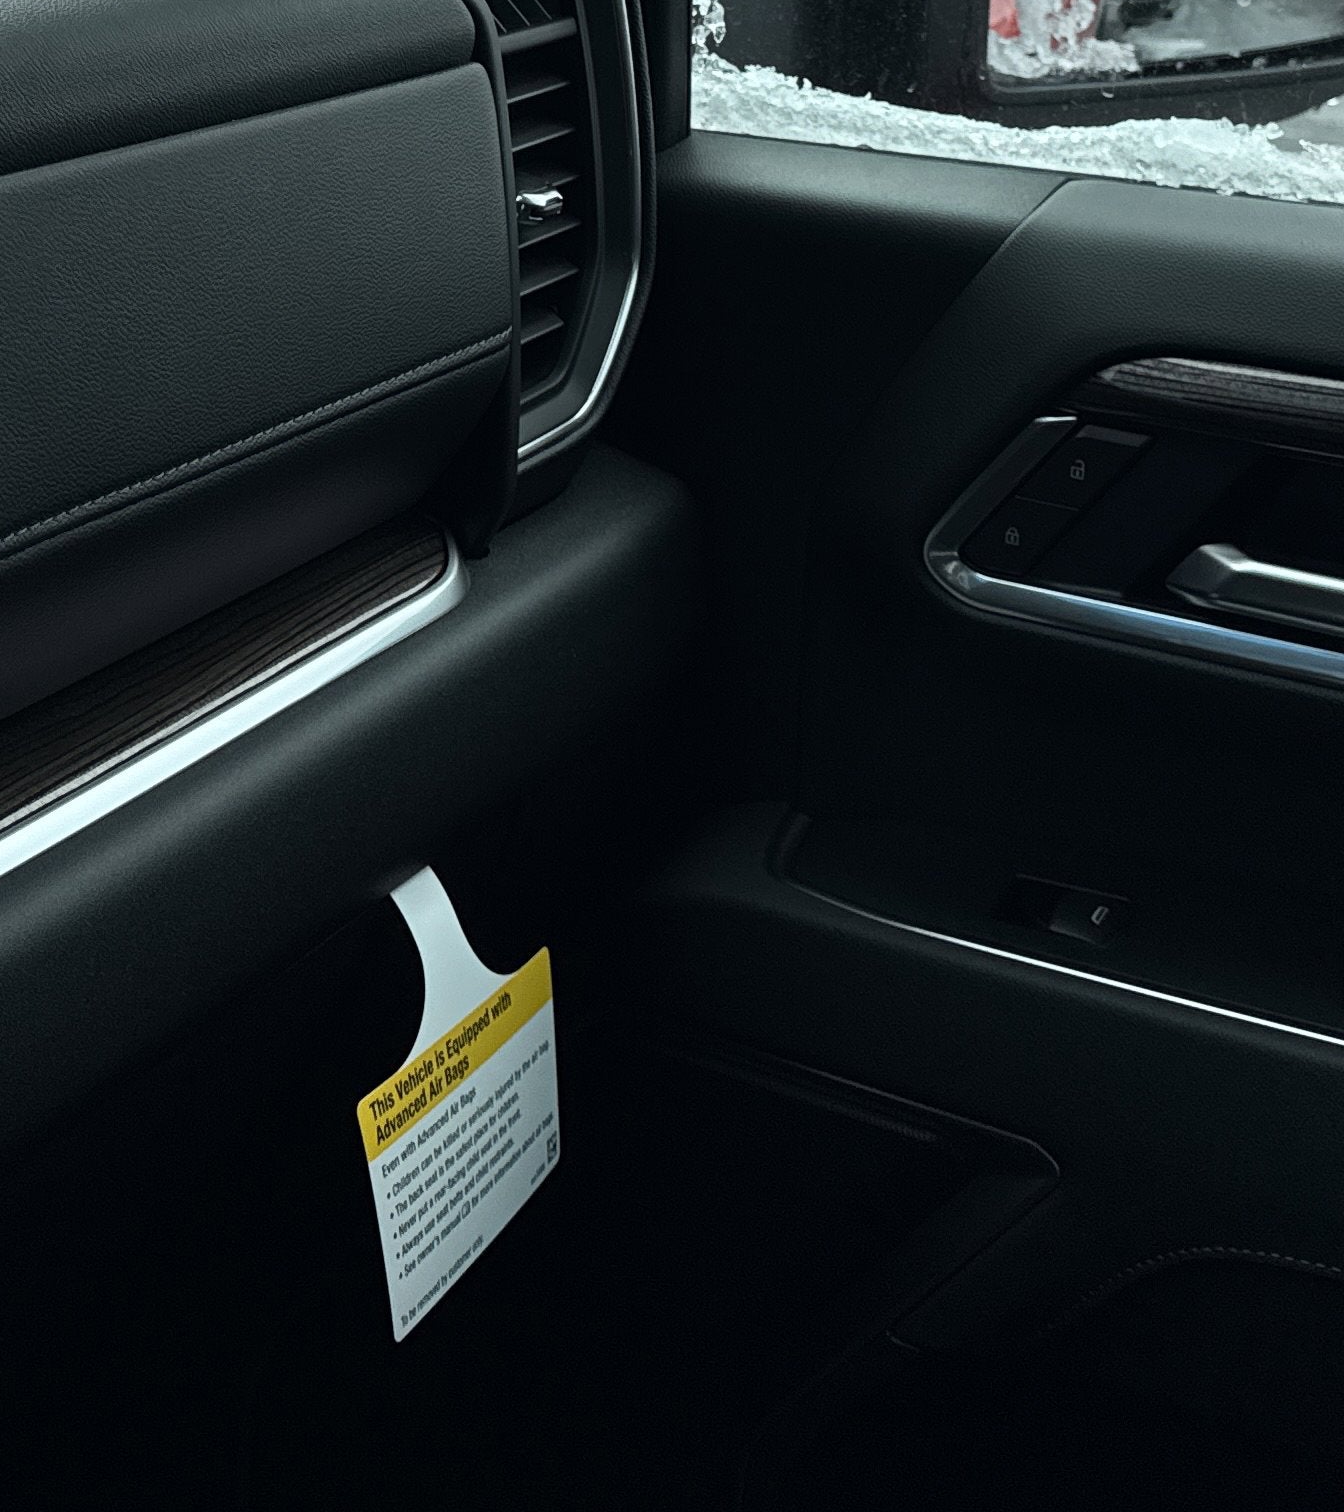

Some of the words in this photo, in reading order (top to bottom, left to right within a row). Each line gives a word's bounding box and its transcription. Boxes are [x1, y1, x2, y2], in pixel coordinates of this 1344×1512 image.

[368, 1091, 395, 1121] This
[394, 1059, 434, 1101] Vehicle
[445, 1007, 491, 1060] Equipped
[490, 991, 512, 1020] with
[376, 1087, 428, 1146] Advanced
[428, 1075, 443, 1102] Air
[443, 1054, 470, 1087] Bags
[380, 1155, 401, 1179] Even
[416, 1108, 450, 1148] Advanced
